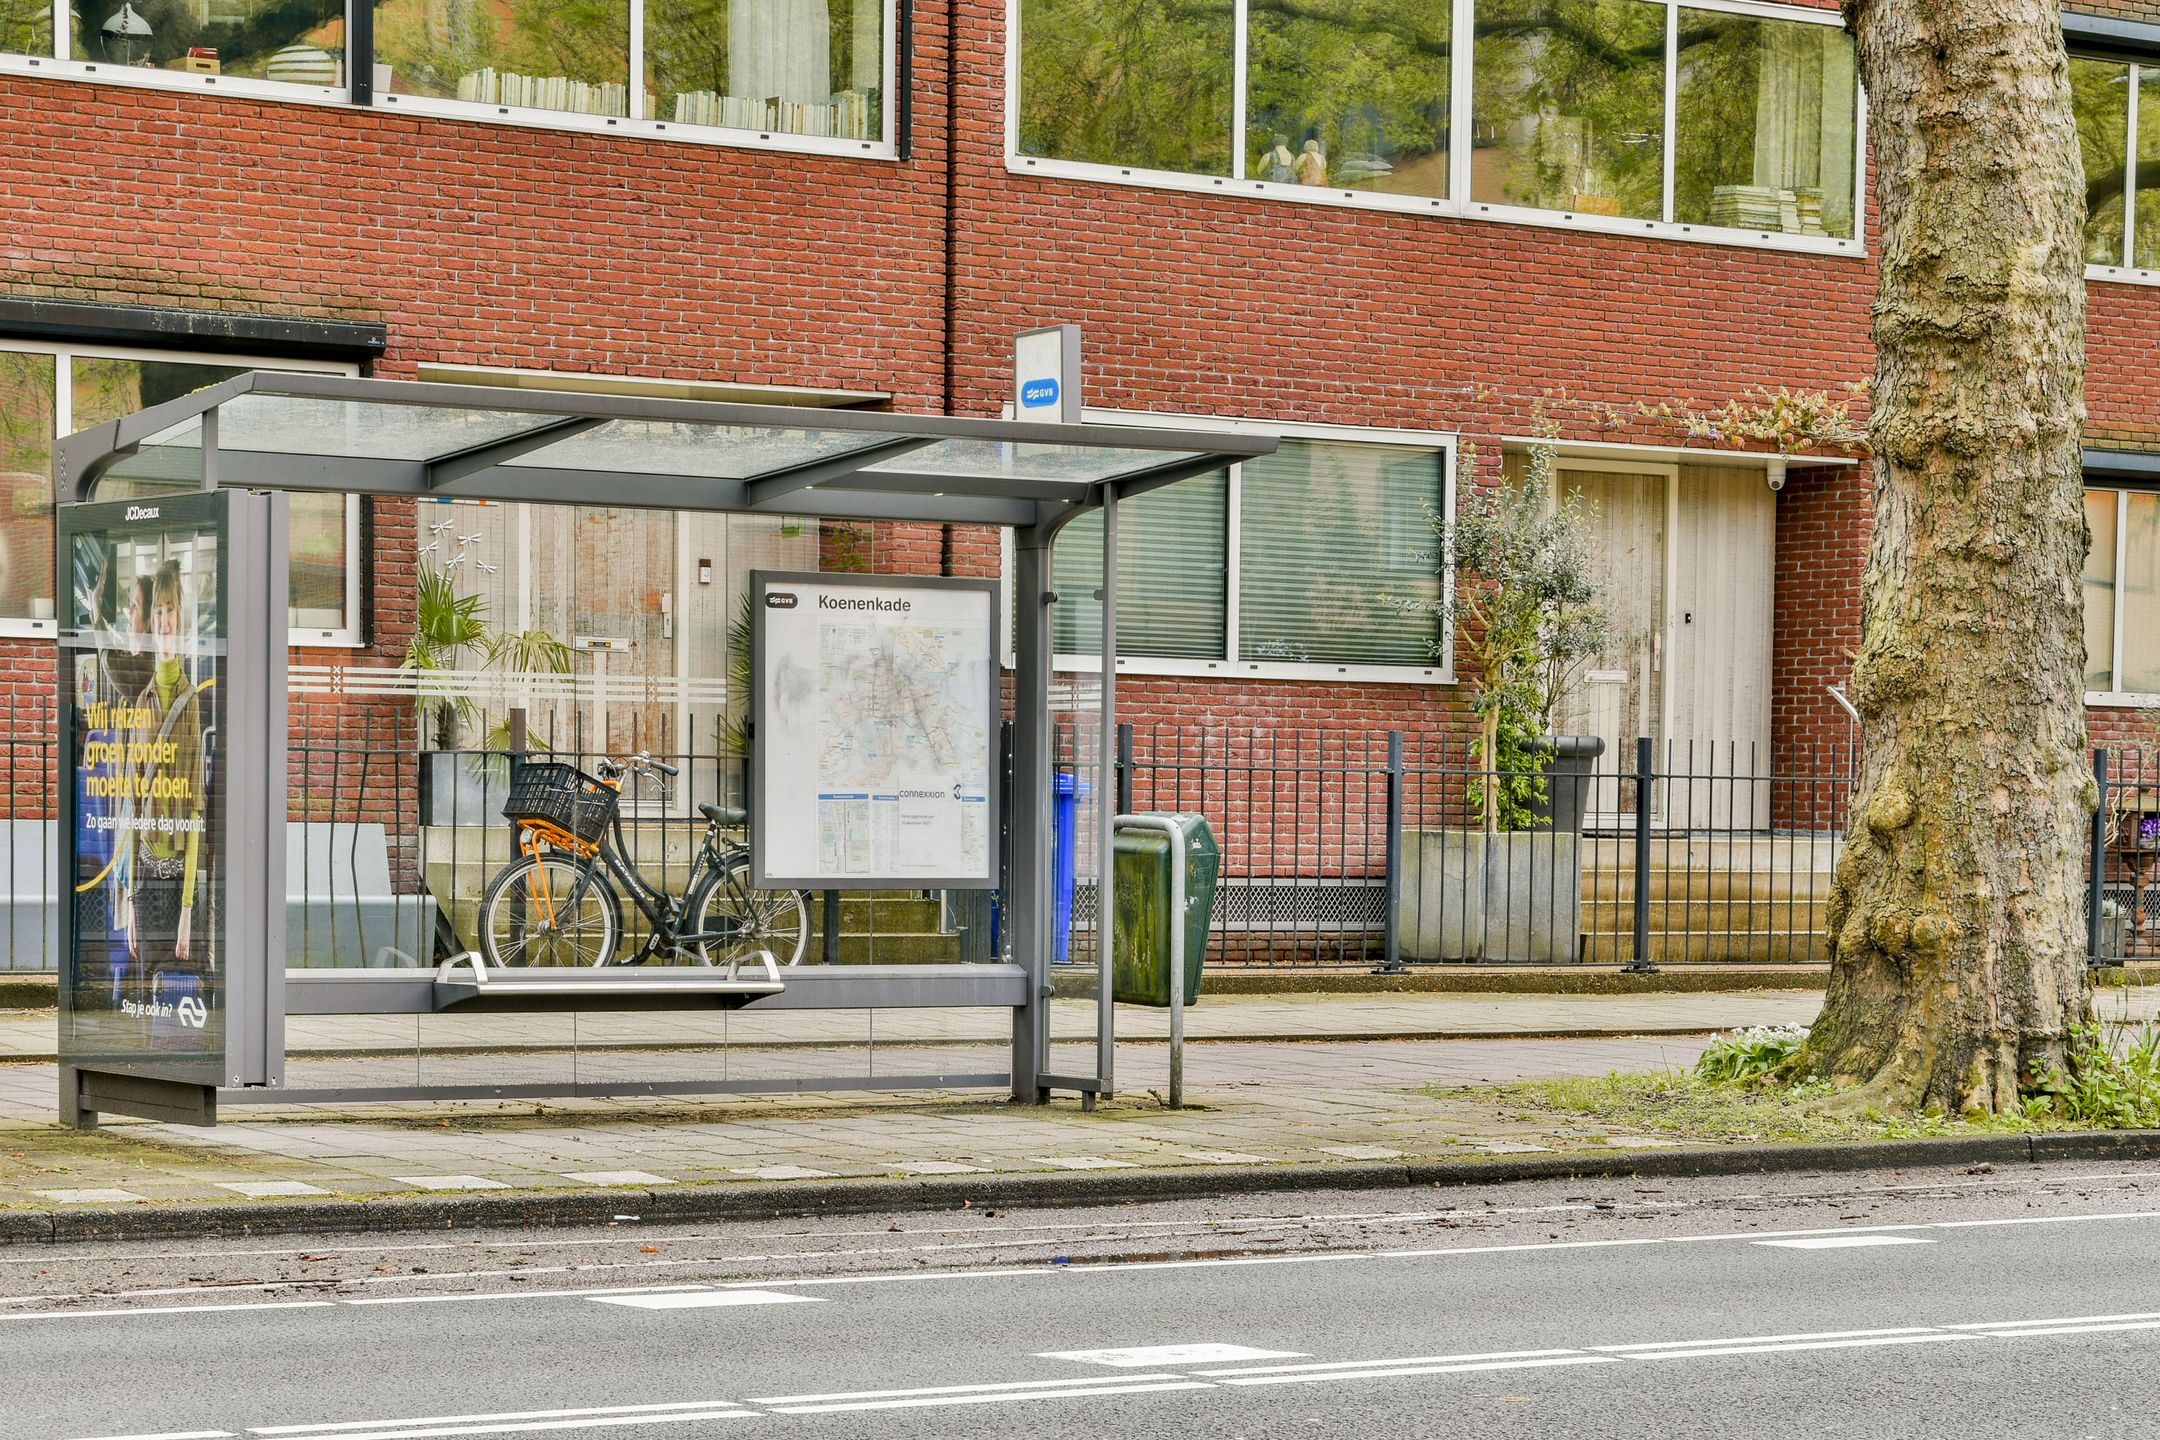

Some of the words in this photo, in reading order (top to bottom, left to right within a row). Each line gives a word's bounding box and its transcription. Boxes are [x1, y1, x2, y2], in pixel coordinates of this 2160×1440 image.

[1039, 387, 1054, 398] GVB
[125, 506, 160, 521] JCDecaux
[818, 594, 911, 612] Koenenkade
[86, 701, 108, 735] Wij
[111, 701, 152, 729] reizen
[87, 741, 124, 770] groen
[127, 735, 179, 764] zonder
[86, 773, 132, 798] moeite
[136, 772, 149, 798] te
[152, 769, 192, 799] doen.
[899, 789, 945, 799] connexxion
[86, 813, 96, 829] Zo
[98, 817, 117, 833] gaan
[118, 817, 130, 830] we
[131, 814, 157, 831] iedere
[158, 814, 174, 835] dag
[175, 816, 206, 833] vooruit.
[121, 998, 136, 1018] Stap
[136, 1000, 145, 1018] je
[145, 1001, 160, 1017] ook
[161, 1002, 173, 1018] in?
